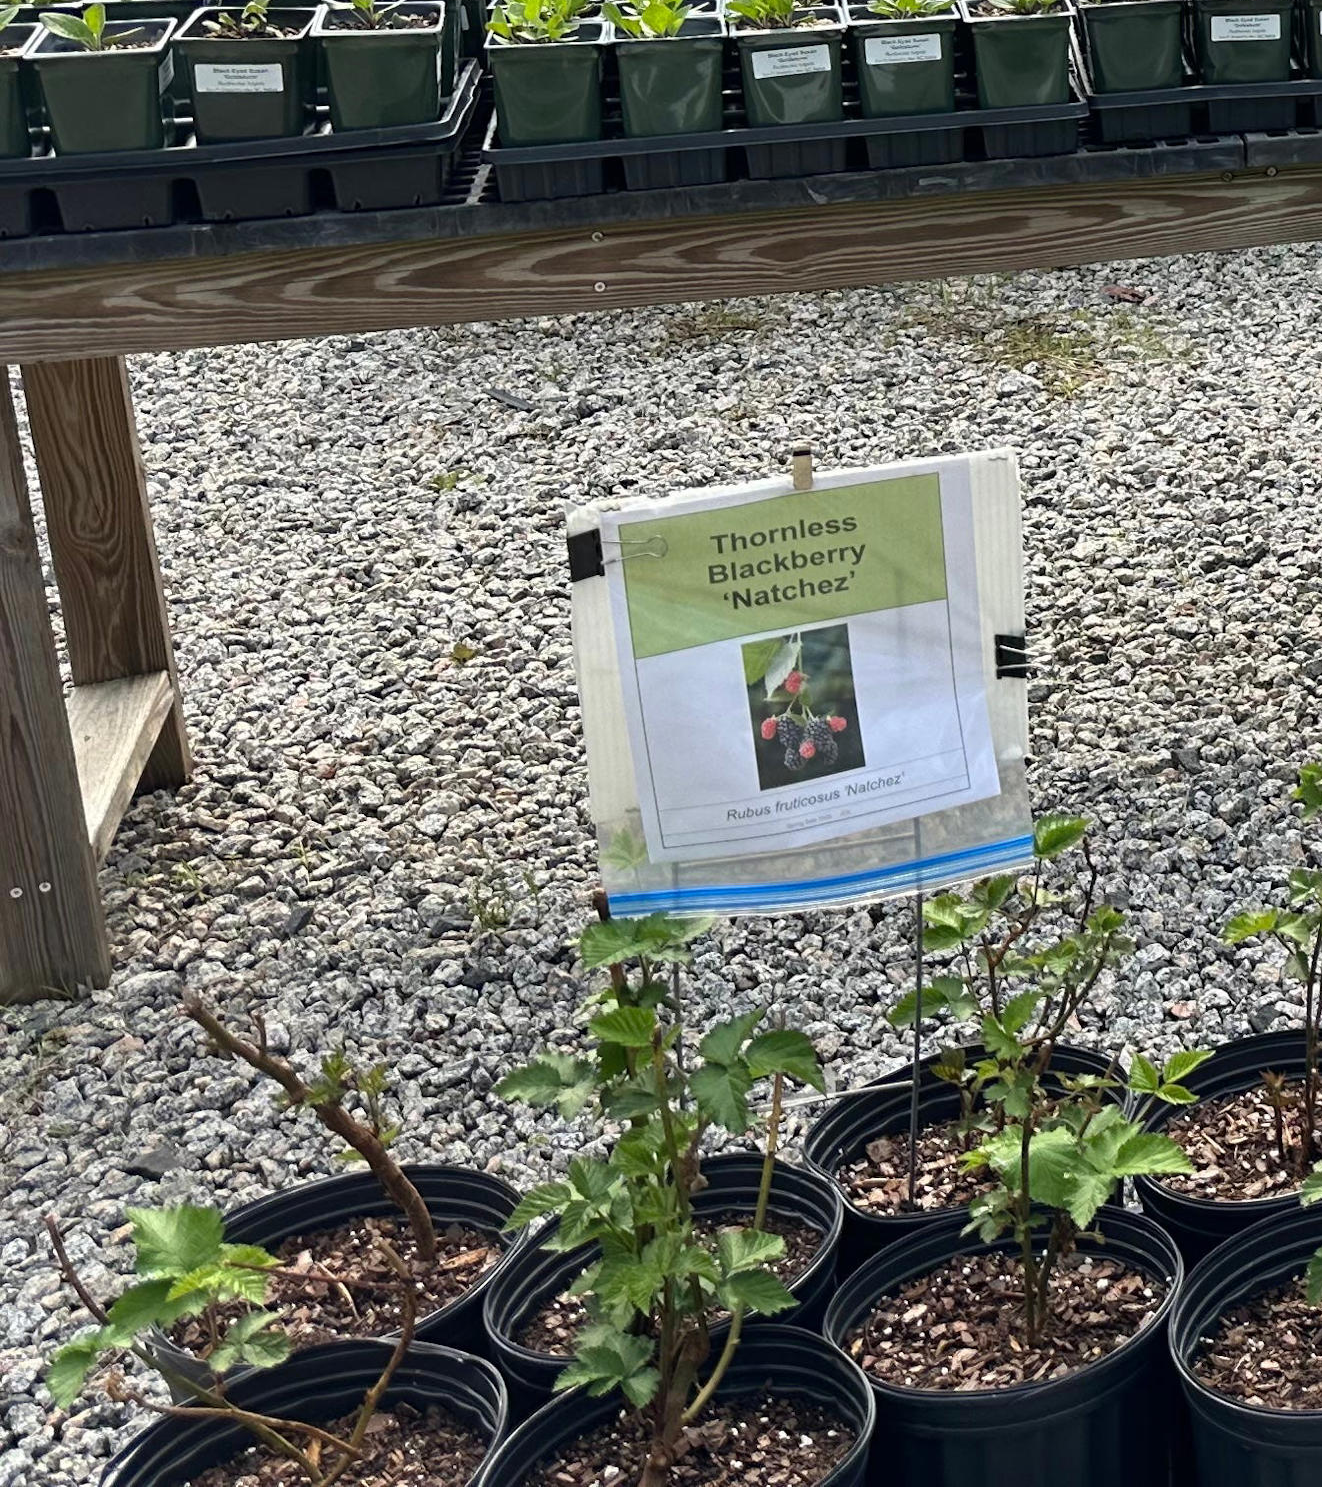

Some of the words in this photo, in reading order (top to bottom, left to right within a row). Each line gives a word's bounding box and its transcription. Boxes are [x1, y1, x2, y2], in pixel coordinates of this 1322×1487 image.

[710, 515, 859, 555] Thornless
[707, 543, 867, 585] Blackberry
[726, 804, 772, 822] Rubus
[775, 789, 841, 814] fruticosus
